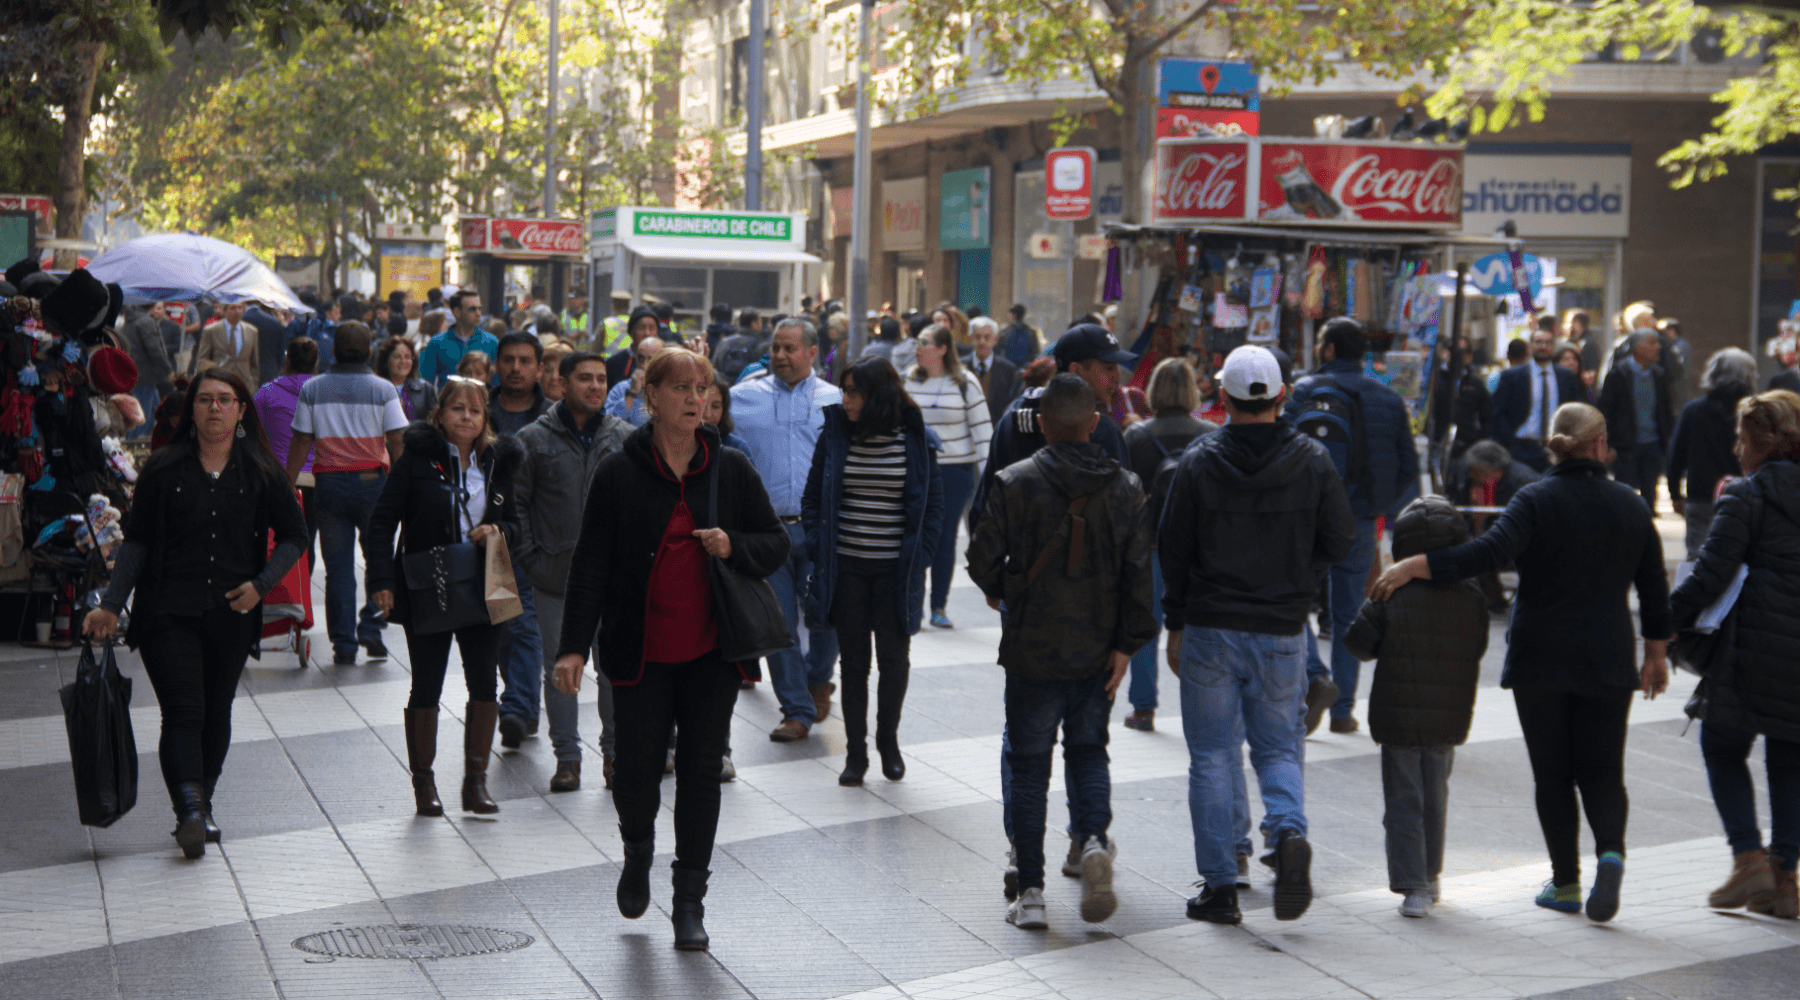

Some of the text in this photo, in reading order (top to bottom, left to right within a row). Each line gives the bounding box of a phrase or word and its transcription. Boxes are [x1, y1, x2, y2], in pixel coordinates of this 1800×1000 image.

[1177, 95, 1244, 108] UEVO LOCAL
[1463, 181, 1621, 213] ahumada
[640, 216, 786, 236] CARABINEROS DE CHILE
